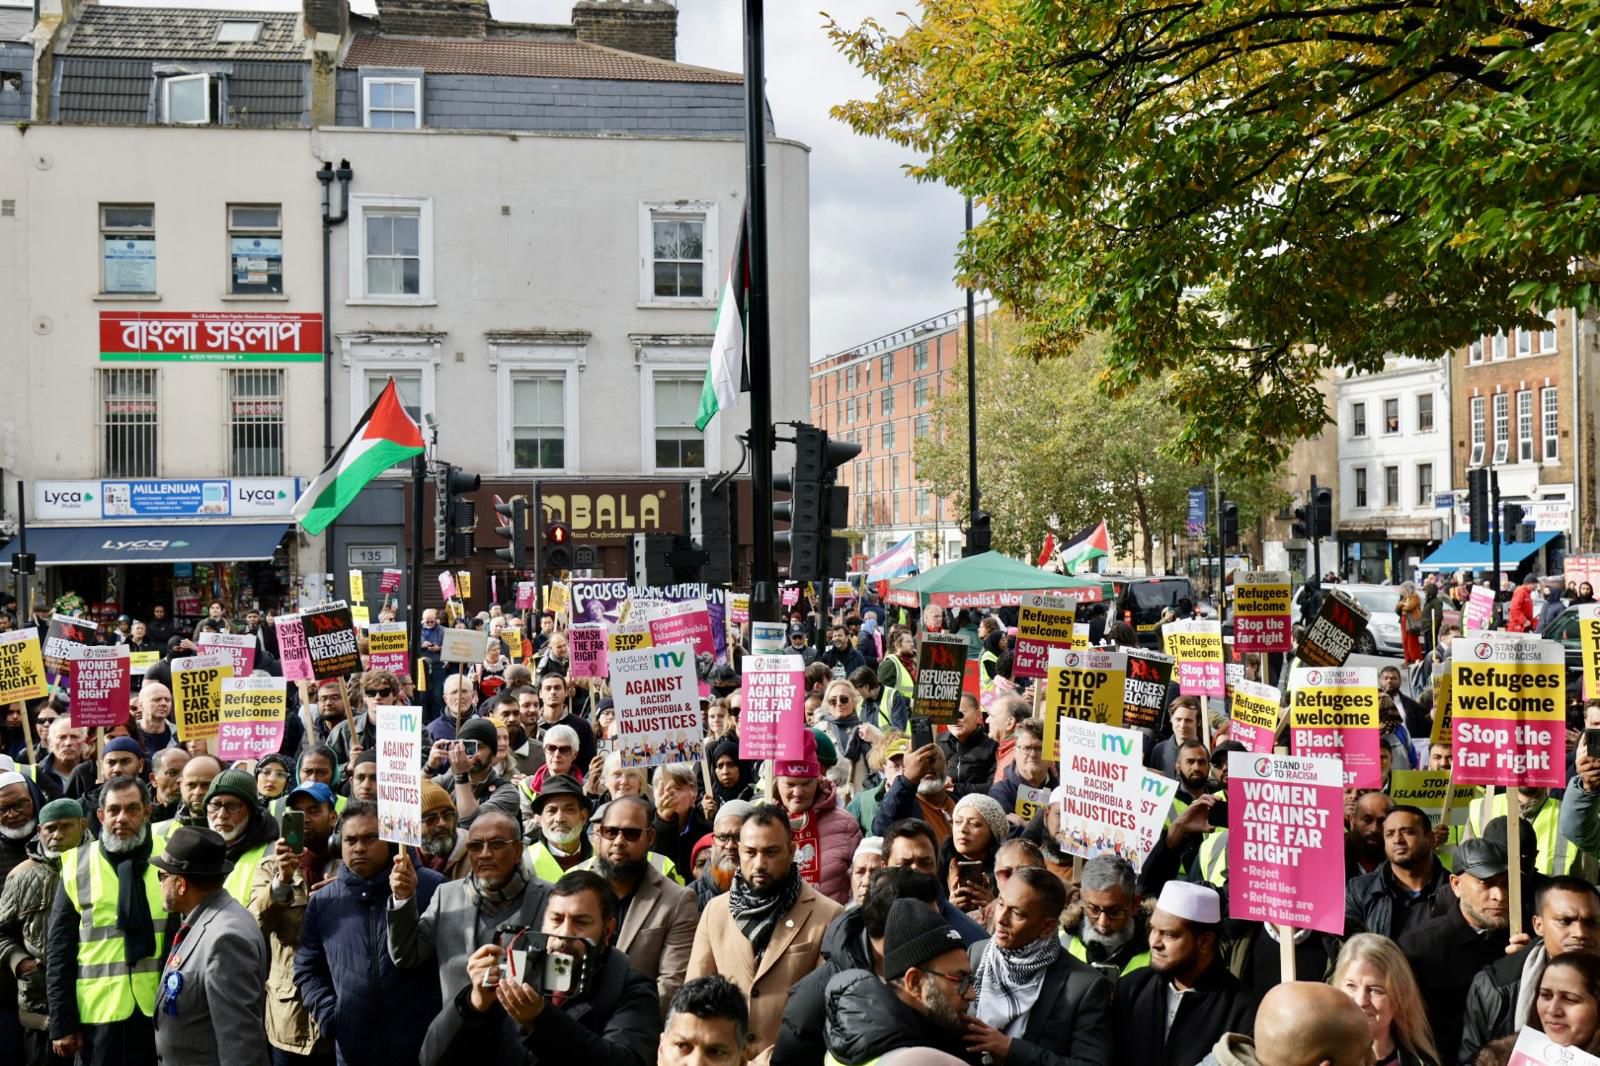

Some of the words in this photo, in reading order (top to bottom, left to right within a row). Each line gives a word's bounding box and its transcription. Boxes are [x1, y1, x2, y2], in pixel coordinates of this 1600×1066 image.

[120, 321, 198, 350] বাংলা
[205, 321, 302, 351] সংলাপ
[134, 484, 200, 494] MILLENIUM
[239, 488, 275, 503] Lyca
[44, 490, 82, 504] Lyca
[102, 540, 170, 549] Lyca
[360, 552, 381, 561] 135
[665, 582, 724, 604] CAMPAIGN
[948, 592, 996, 606] Socialist
[1237, 588, 1288, 601] Refugees
[1237, 600, 1286, 612] welcome
[1022, 609, 1072, 625] Refugees
[1237, 619, 1259, 630] Stop
[1266, 619, 1284, 629] the
[280, 622, 304, 636] SMAS
[652, 620, 683, 632] Oppose
[654, 624, 708, 640] Islamophobia
[1021, 624, 1068, 638] welcome
[1314, 616, 1354, 651] REFUGEES
[282, 636, 296, 648] THE
[308, 629, 354, 648] REFUGEES
[371, 634, 406, 642] Refugees
[573, 630, 600, 640] SMASH
[616, 634, 643, 645] STOP
[1180, 636, 1220, 648] Refugees
[1237, 633, 1253, 643] far
[1257, 632, 1283, 646] right
[0, 642, 26, 657] TOP
[311, 641, 357, 660] WELCOME
[574, 641, 588, 650] THE
[590, 641, 604, 650] FAR
[1018, 641, 1044, 657] Stop
[1308, 627, 1347, 662] WELCOME
[284, 648, 307, 661] RIGHT
[371, 655, 389, 664] Stop
[574, 651, 598, 661] RIGHT
[616, 655, 648, 664] MUSLIM
[1180, 648, 1220, 658] welcome
[77, 660, 118, 670] WOMEN
[616, 662, 648, 672] VOICES
[1016, 656, 1033, 668] far
[78, 669, 124, 680] AGAINST
[180, 670, 218, 685] STOP
[920, 669, 960, 685] REFUGEES
[1181, 664, 1204, 677] Stop
[1206, 665, 1220, 675] the
[0, 674, 37, 691] RIGHT
[78, 680, 98, 689] THE
[100, 680, 120, 688] FAR
[626, 676, 683, 695] AGAINST
[748, 674, 790, 685] WOMEN
[1059, 670, 1107, 689] STOP
[1125, 678, 1165, 696] EFUGEES
[1182, 677, 1195, 687] far
[1199, 676, 1220, 689] right
[1458, 667, 1560, 693] Refugees
[78, 688, 110, 699] RIGHT
[182, 684, 210, 698] THE
[748, 686, 796, 698] AGAINST
[918, 684, 958, 700] WELCOME
[1058, 688, 1094, 707] THE
[183, 698, 210, 712] FAR
[224, 694, 282, 706] Refugees
[640, 694, 671, 705] RACISM
[748, 698, 768, 710] THE
[772, 698, 792, 710] FAR
[1124, 691, 1162, 709] ELCOME
[1235, 694, 1276, 716] Refugees
[1296, 691, 1373, 710] Refugees
[1458, 692, 1555, 712] welcome
[184, 710, 220, 725] RIGH
[224, 707, 280, 718] welcome
[622, 704, 682, 718] ISLAMOPHOBIA
[685, 702, 692, 711] &
[748, 711, 782, 722] RIGHT
[1057, 706, 1091, 723] FAR
[620, 714, 697, 734] INJUSTICES
[1234, 709, 1272, 728] welcome
[1296, 711, 1370, 725] welcome
[222, 726, 252, 738] Stop
[256, 724, 277, 736] the
[1232, 721, 1256, 739] Black
[1457, 723, 1509, 749] Stop
[1515, 725, 1552, 745] the
[222, 740, 240, 751] far
[244, 738, 275, 753] right
[1296, 730, 1344, 747] Black
[383, 741, 414, 759] AGAINST
[390, 760, 406, 770] RACISM
[1072, 754, 1128, 782] AGAINST
[1274, 761, 1300, 770] STAND
[1302, 762, 1314, 771] UP
[1458, 748, 1490, 767] far
[1497, 749, 1550, 774] right
[1286, 771, 1317, 780] RACISM
[1084, 777, 1113, 793] RACISM
[379, 784, 418, 804] INJUSTICES
[1066, 784, 1123, 808] ISLAMOPHOBIA
[1126, 800, 1133, 811] &
[1242, 781, 1317, 807] WOMEN
[1064, 797, 1136, 830] INJUSTICES
[1243, 802, 1329, 829] AGAINST
[1243, 822, 1279, 843] THE
[1285, 827, 1322, 848] FAR
[1244, 842, 1302, 866] RIGHT
[1249, 866, 1280, 879] Reject
[1249, 879, 1276, 892] racist
[1278, 882, 1296, 894] lies
[1250, 892, 1293, 908] Refugees
[1296, 901, 1314, 911] are
[1249, 906, 1266, 915] not
[1269, 908, 1277, 917] to
[1279, 910, 1311, 923] blame
